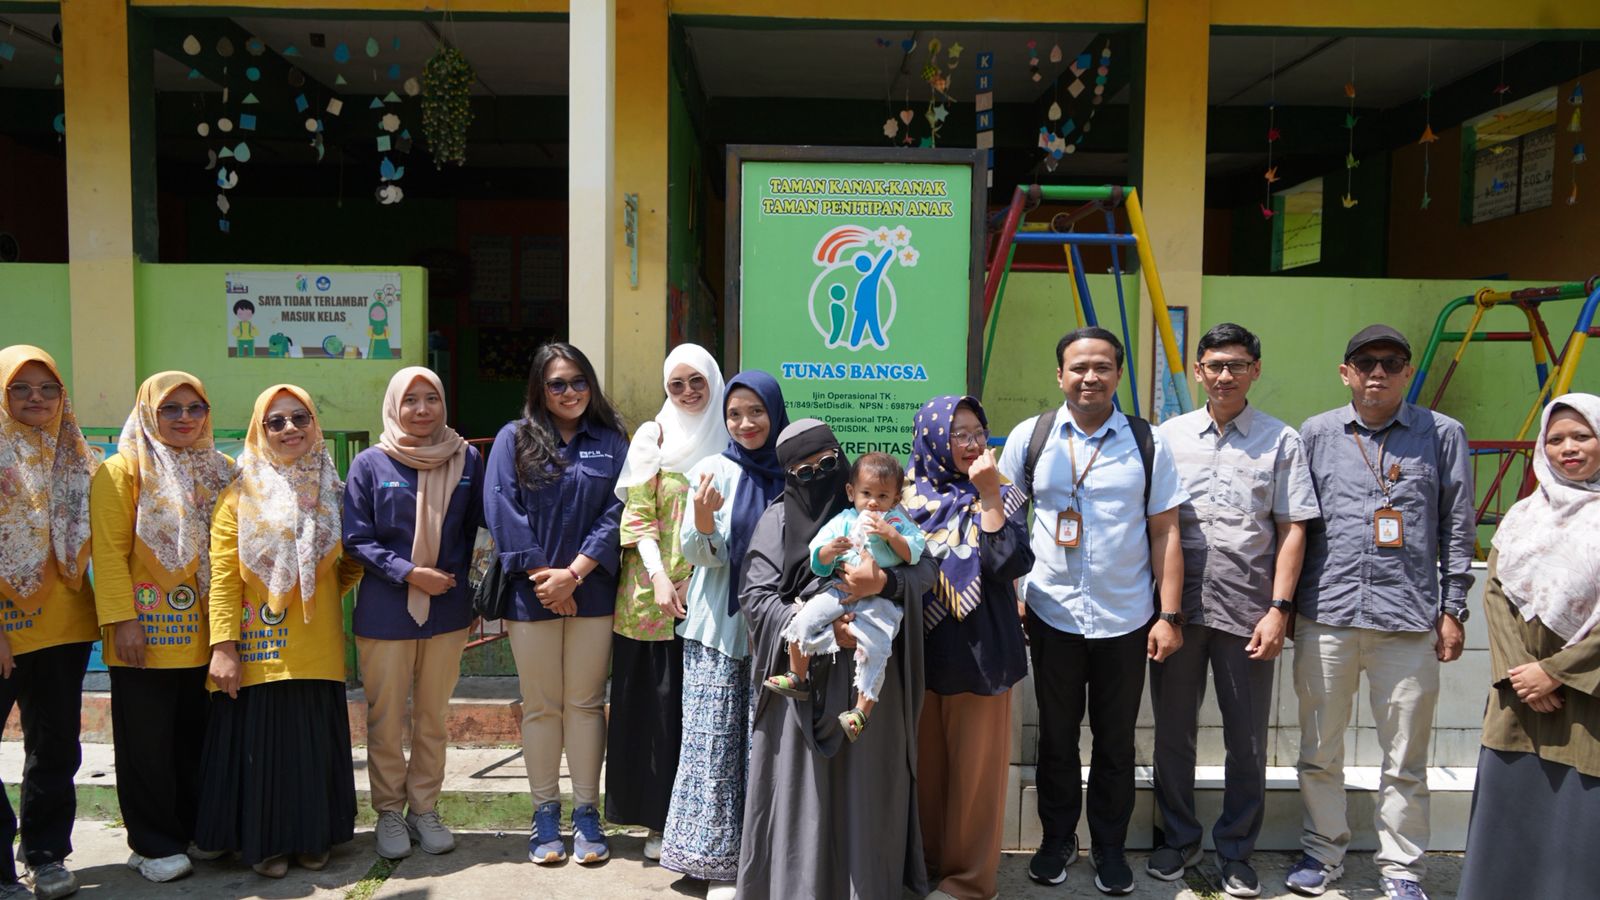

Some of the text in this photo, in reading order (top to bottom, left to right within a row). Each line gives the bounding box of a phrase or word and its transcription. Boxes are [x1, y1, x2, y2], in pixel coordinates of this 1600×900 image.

[770, 179, 946, 196] TAMAN KANAK-KANAK
[763, 199, 953, 217] TAMAN PENITIPAN ANAK
[258, 295, 368, 307] SAYA TIDAK TERLAMBAT
[281, 311, 346, 323] MASUK KELAS
[782, 363, 928, 380] TUNAS BANGSA
[812, 392, 825, 400] Ijin
[827, 392, 877, 400] Operasional
[825, 415, 875, 423] Operasional
[188, 613, 199, 622] 11
[278, 627, 288, 637] 11
